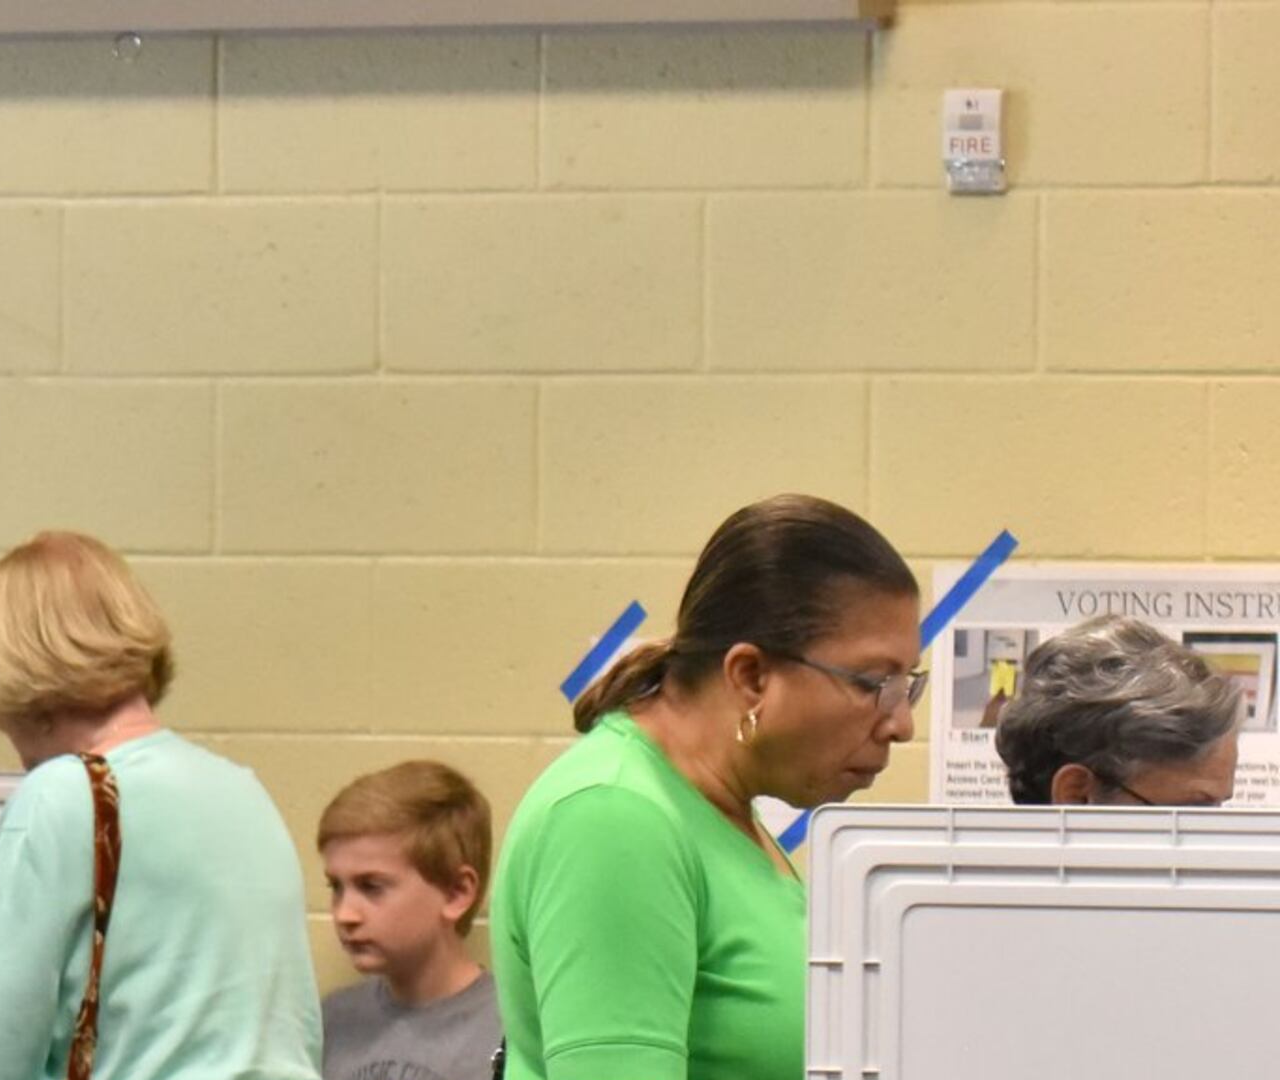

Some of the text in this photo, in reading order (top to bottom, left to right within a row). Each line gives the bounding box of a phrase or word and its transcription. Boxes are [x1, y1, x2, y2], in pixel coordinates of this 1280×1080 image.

[949, 136, 992, 154] FIRE
[1056, 589, 1280, 619] VOTING INSTR
